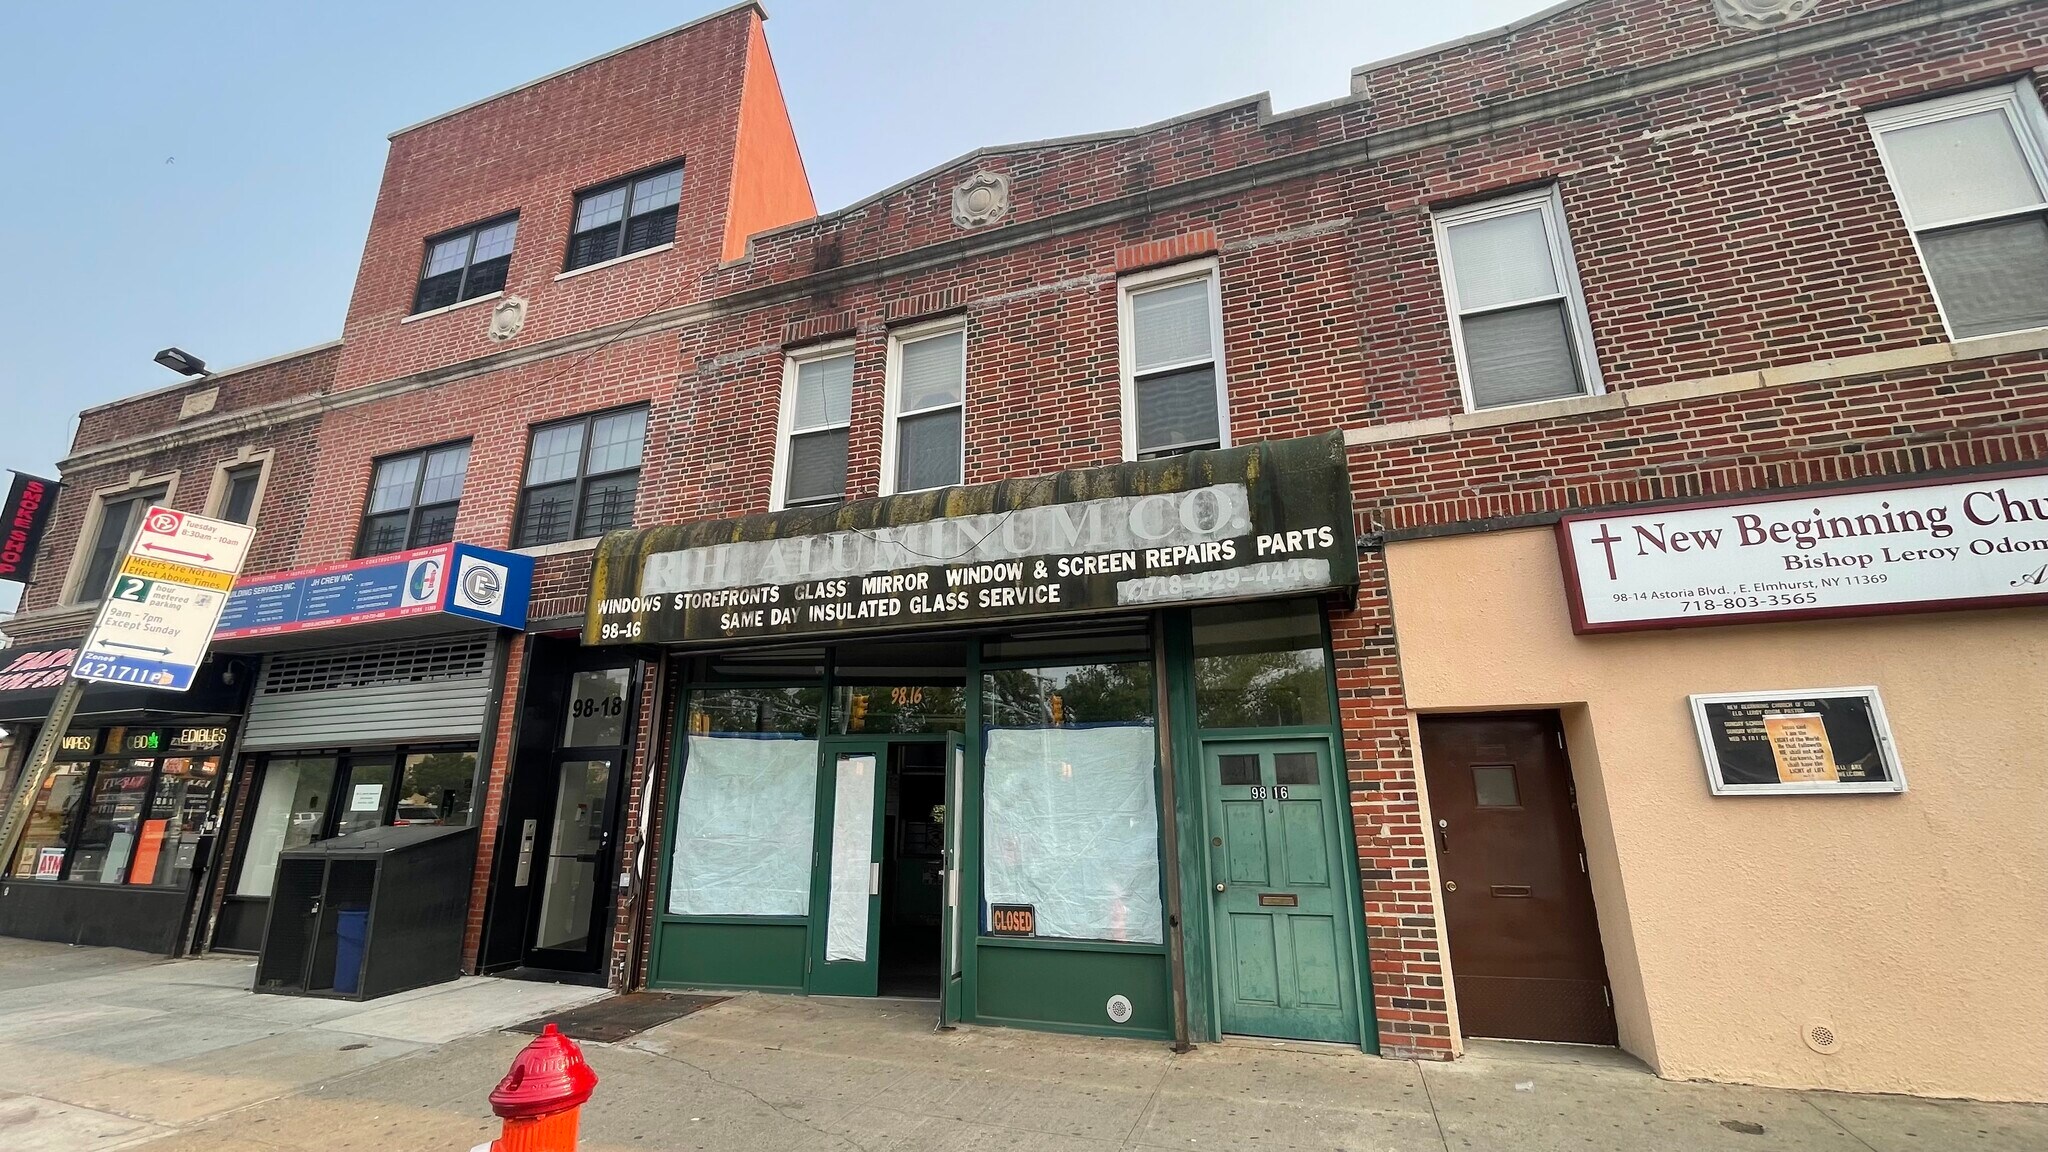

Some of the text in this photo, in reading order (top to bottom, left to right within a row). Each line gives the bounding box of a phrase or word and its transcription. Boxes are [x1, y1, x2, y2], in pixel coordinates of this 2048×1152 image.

[14, 480, 45, 529] SMOKE
[181, 528, 212, 540] 8:30am
[219, 536, 239, 546] 10am
[186, 520, 217, 533] Tuesday
[757, 502, 1106, 578] ALUMINUM
[1129, 487, 1245, 540] CO.
[1632, 522, 1723, 556] New
[1732, 501, 1954, 550] Beginning
[132, 557, 166, 570] Meters
[168, 565, 187, 574] Are
[189, 567, 205, 577] Not
[1784, 552, 1873, 570] Bishop
[1881, 547, 1960, 562] Leroy
[128, 566, 220, 589] Effect Above Times
[320, 575, 341, 585] CREW
[341, 573, 354, 582] INC.
[597, 526, 1334, 615] WINDOWS STOREFRONTS GLASS MIRROR WINDOW & SCREEN REPAIRS PARTS
[1145, 559, 1318, 597] 718-429-4446
[120, 578, 145, 601] 2
[152, 592, 189, 604] metered
[156, 585, 176, 594] hour
[253, 584, 283, 595] SERVICES
[1612, 591, 1647, 602] 98-14
[1651, 588, 1695, 600] Astoria
[1739, 583, 1751, 593] E.
[1755, 579, 1818, 592] Elmhurst,
[1822, 577, 1841, 588] NY
[1845, 574, 1888, 586] 11369
[149, 599, 182, 611] parking
[720, 583, 1061, 630] SAME DAY INSULATED GLASS SERVICE
[1680, 592, 1817, 612] 718-803-3565
[109, 607, 132, 619] 9am
[142, 612, 163, 624] 7pm
[105, 617, 181, 638] Except Sunday
[602, 621, 641, 640] 98-16
[85, 652, 116, 663] Zone#
[79, 661, 149, 683] 421711
[573, 696, 622, 718] 98-18
[62, 736, 91, 750] VAPES
[181, 728, 227, 743] EDIBLES
[1251, 786, 1288, 799] 98 16
[39, 855, 64, 874] ATM
[994, 910, 1032, 931] CLOSED
